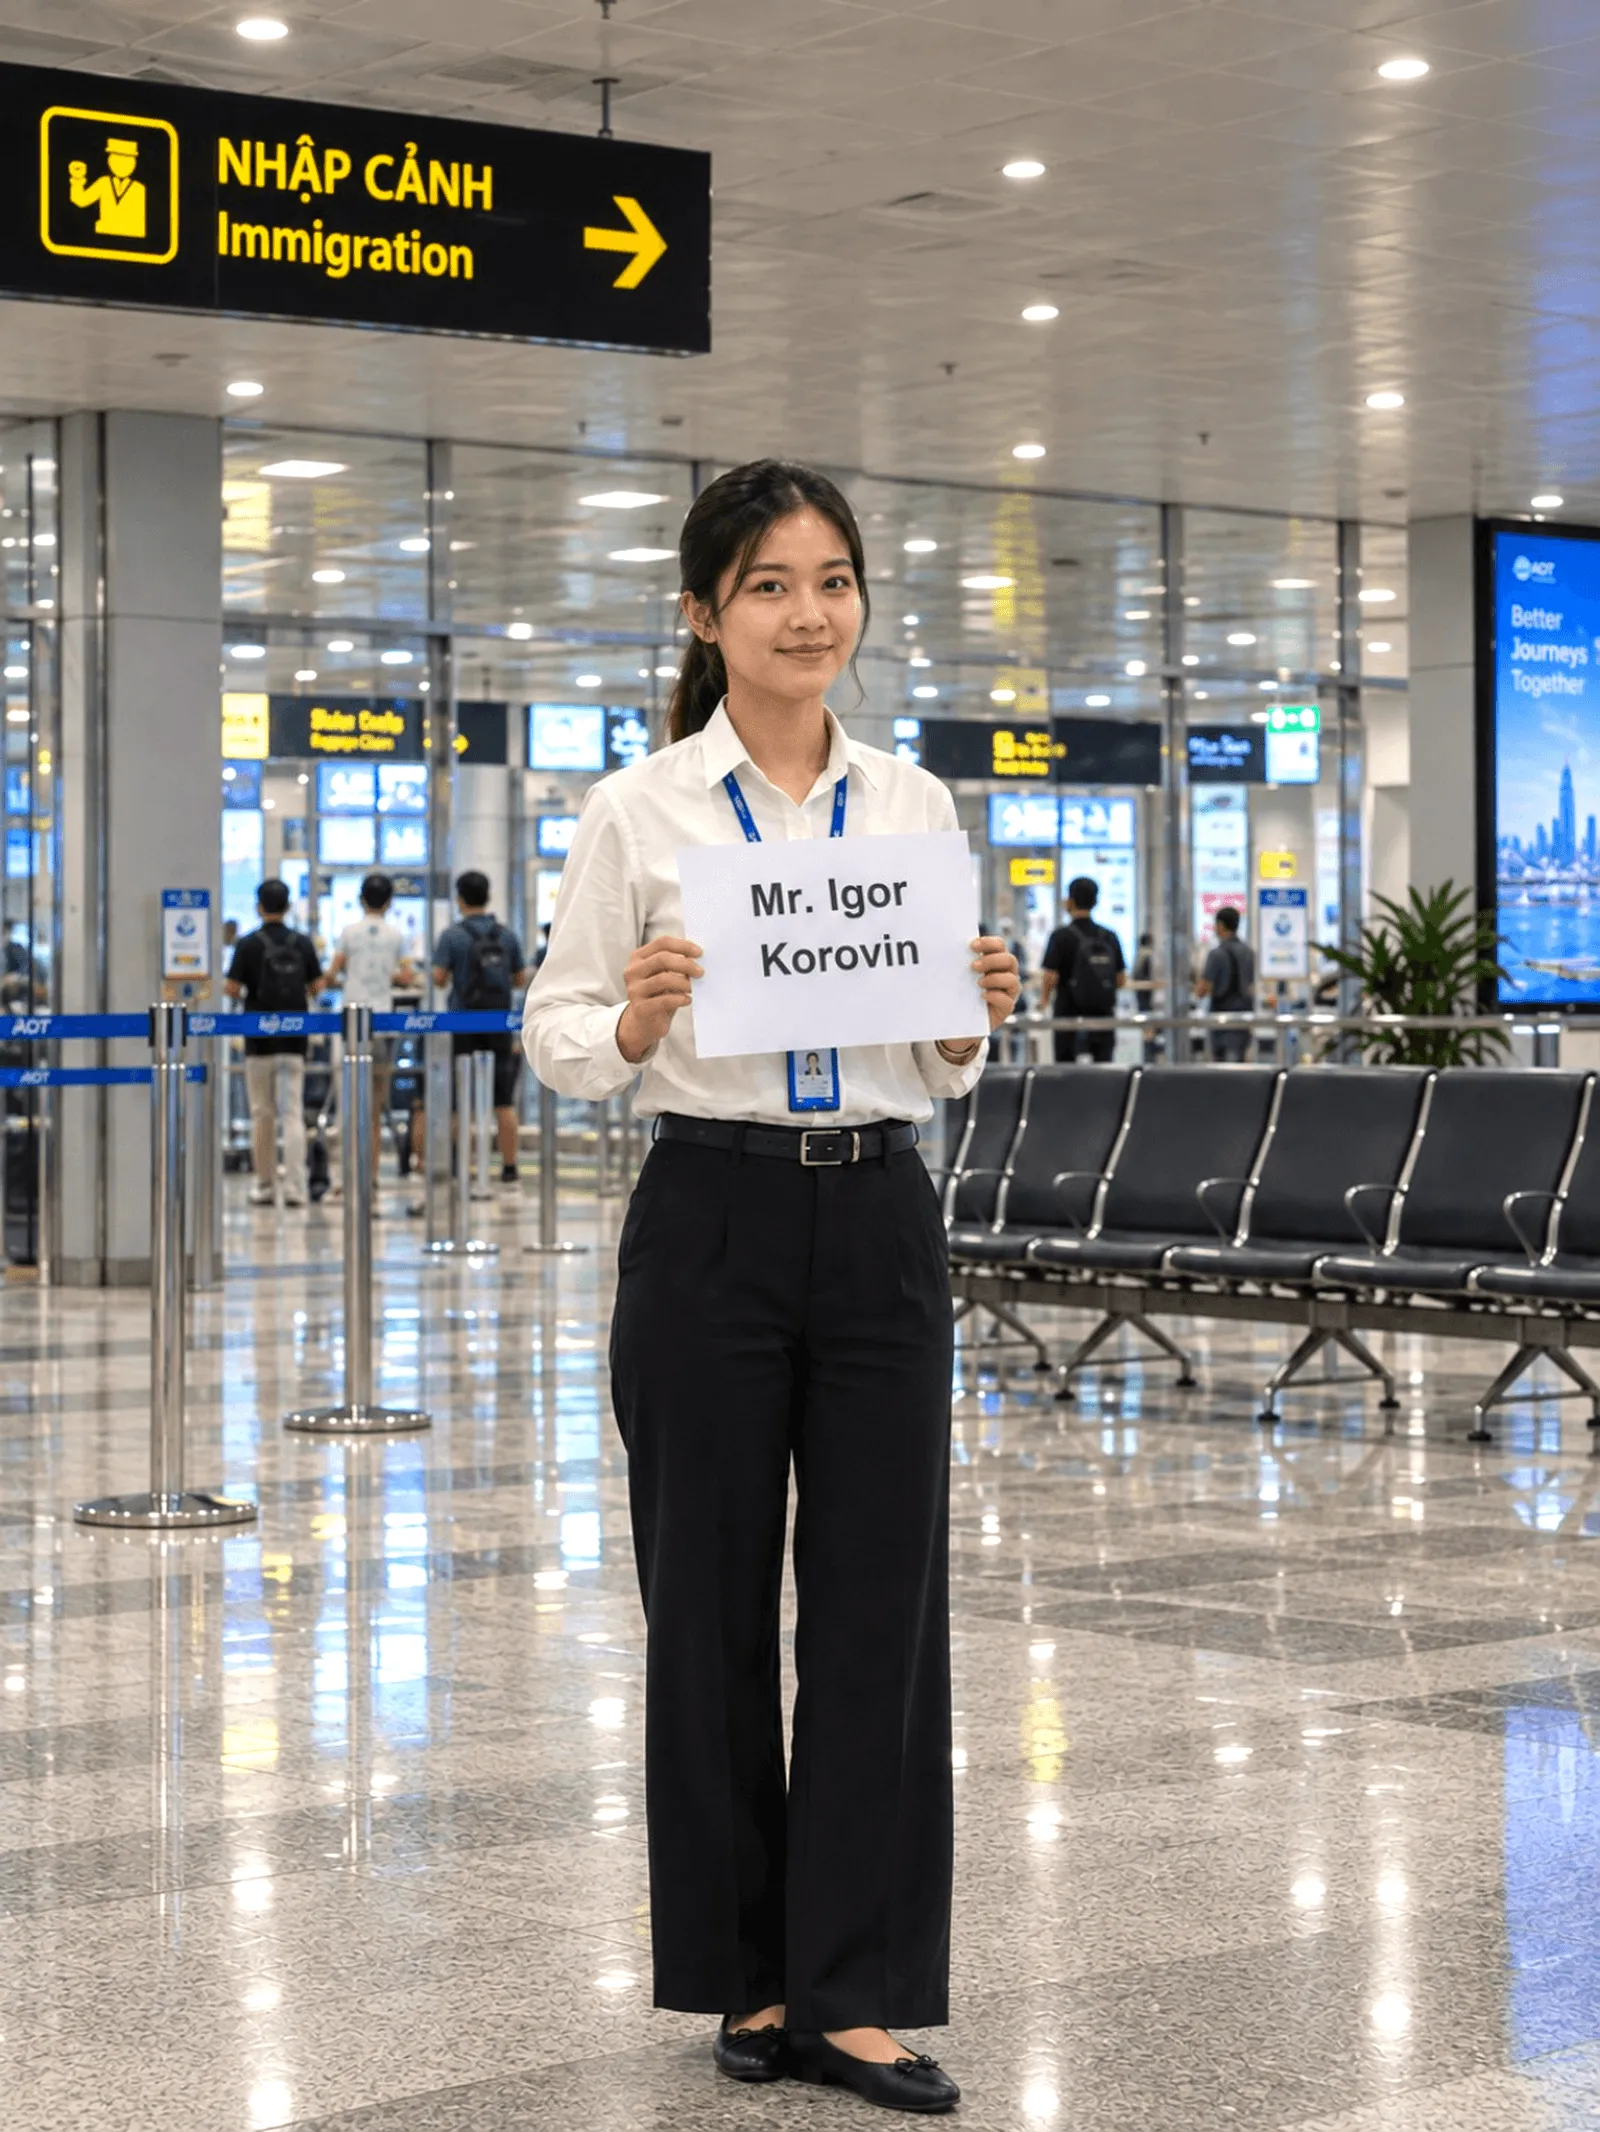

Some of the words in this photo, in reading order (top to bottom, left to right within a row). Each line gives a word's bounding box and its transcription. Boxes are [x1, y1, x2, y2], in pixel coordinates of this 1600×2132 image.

[217, 133, 352, 204] NHẬP
[364, 141, 493, 211] CẢNH
[217, 210, 474, 280] Immigration
[1511, 604, 1563, 630] Better
[1511, 636, 1588, 668] Journeys
[1511, 669, 1585, 698] Together
[750, 882, 814, 917] Mr.
[828, 878, 908, 919] Igor
[760, 933, 919, 978] Korovin
[11, 1017, 52, 1036] AOT
